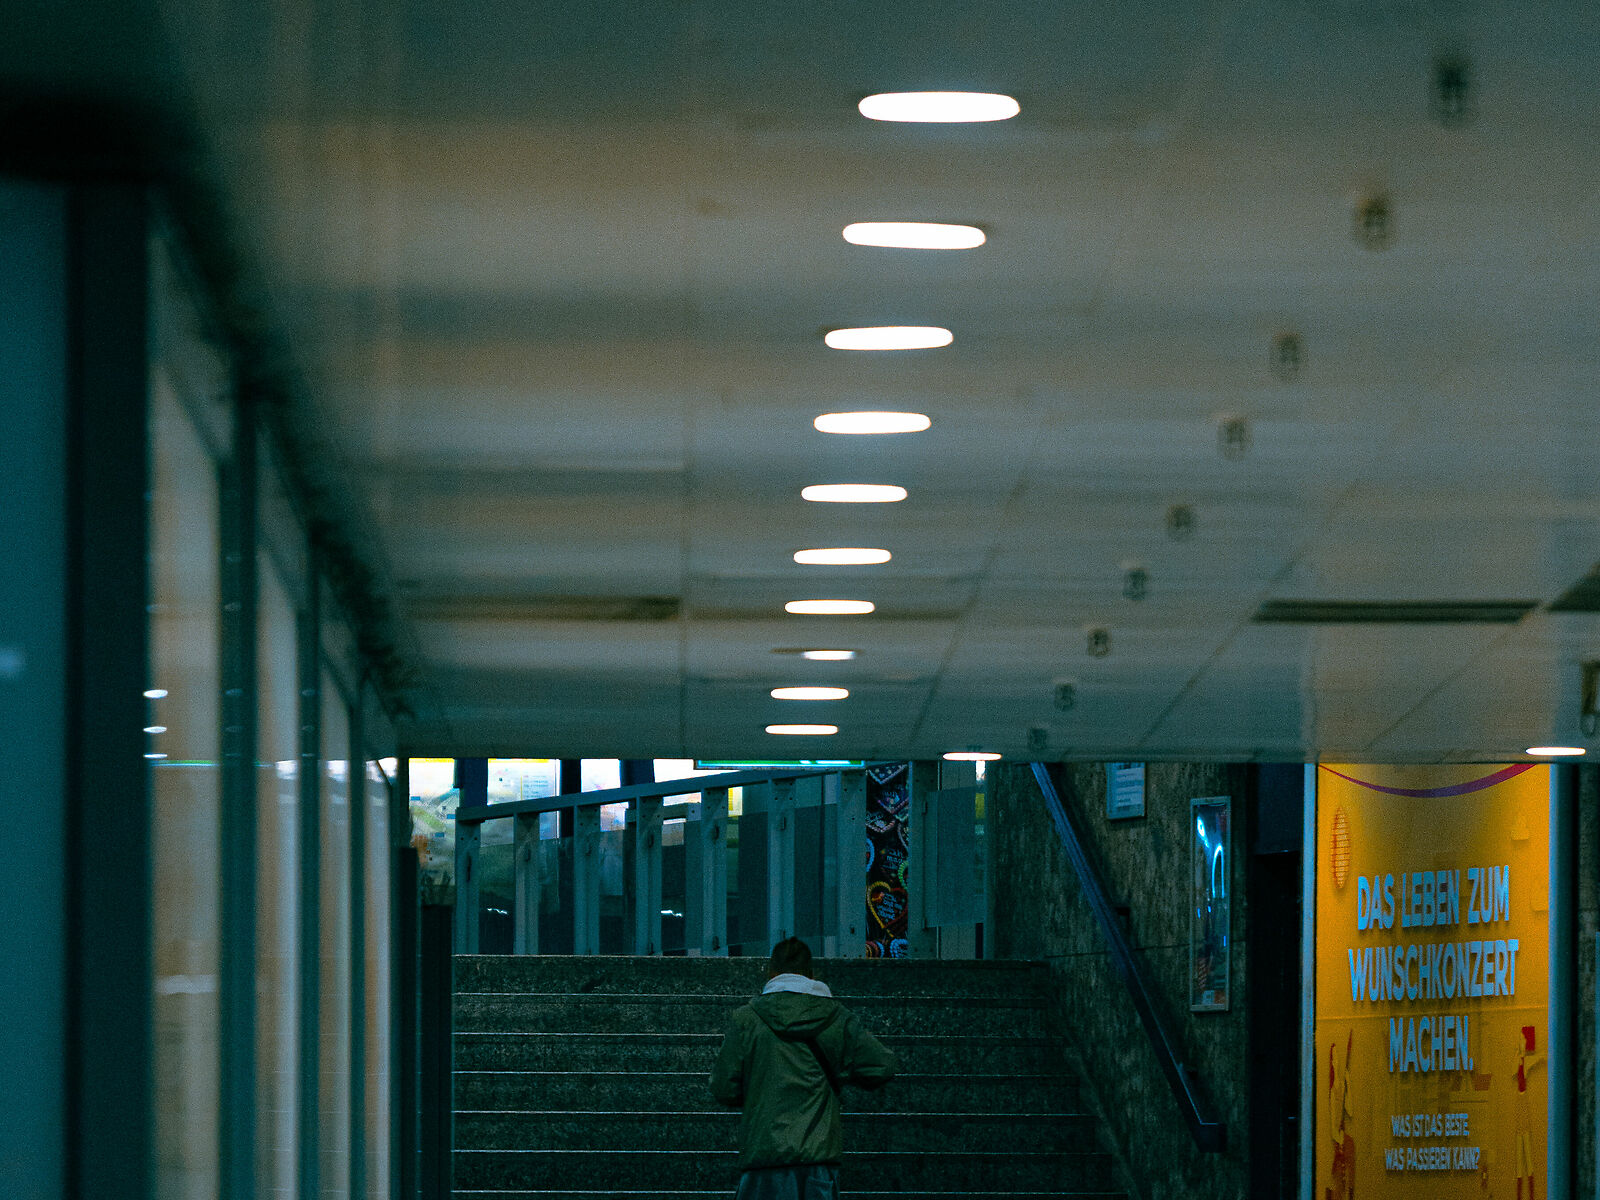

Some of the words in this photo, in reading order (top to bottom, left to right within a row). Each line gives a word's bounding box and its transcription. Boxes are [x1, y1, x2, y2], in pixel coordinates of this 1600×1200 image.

[1357, 873, 1395, 931] DAS
[1401, 869, 1460, 928] LEBEN
[1467, 864, 1510, 924] ZUM
[1348, 939, 1519, 1002] WUNSCHKONZERT
[1389, 1015, 1474, 1073] MACHEN.
[1391, 1114, 1411, 1137] WAS
[1412, 1114, 1424, 1137] IST
[1425, 1113, 1443, 1137] DAS
[1445, 1112, 1470, 1136] BESTE
[1384, 1147, 1404, 1170] WAS
